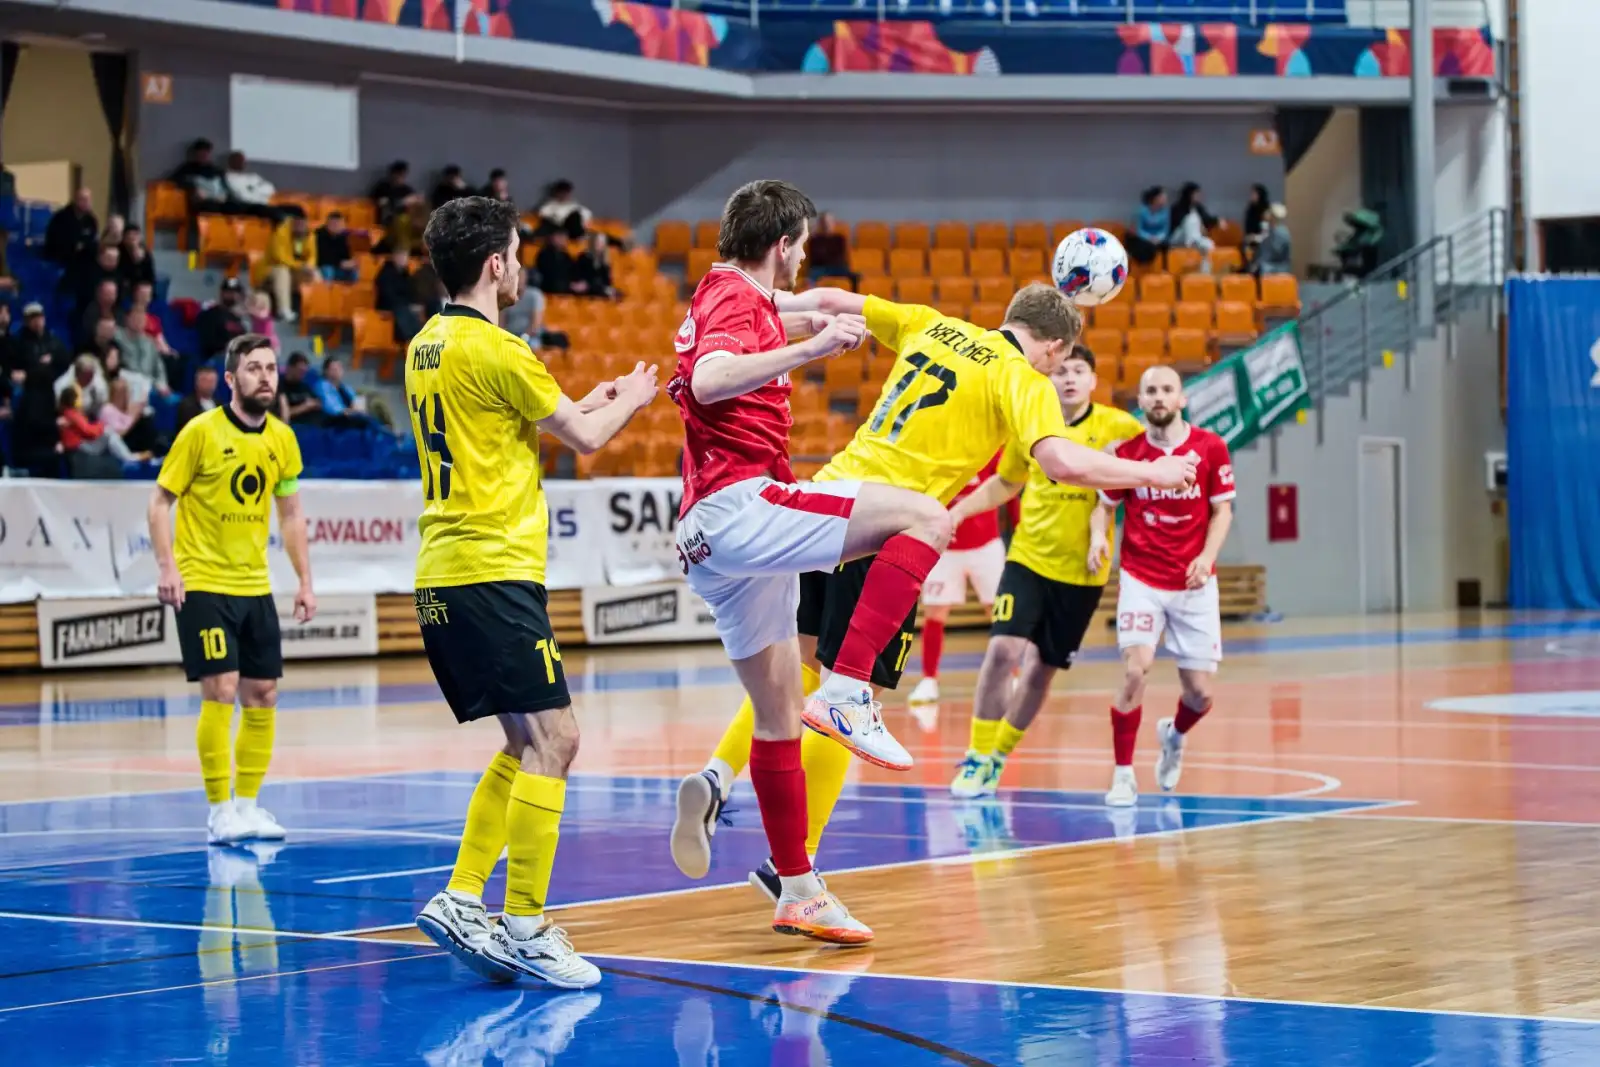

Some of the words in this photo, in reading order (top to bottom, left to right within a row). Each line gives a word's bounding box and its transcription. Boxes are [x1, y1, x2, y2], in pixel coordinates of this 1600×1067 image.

[869, 351, 957, 443] 17
[411, 393, 453, 500] 14
[200, 627, 227, 660] 10
[1120, 612, 1154, 632] 33
